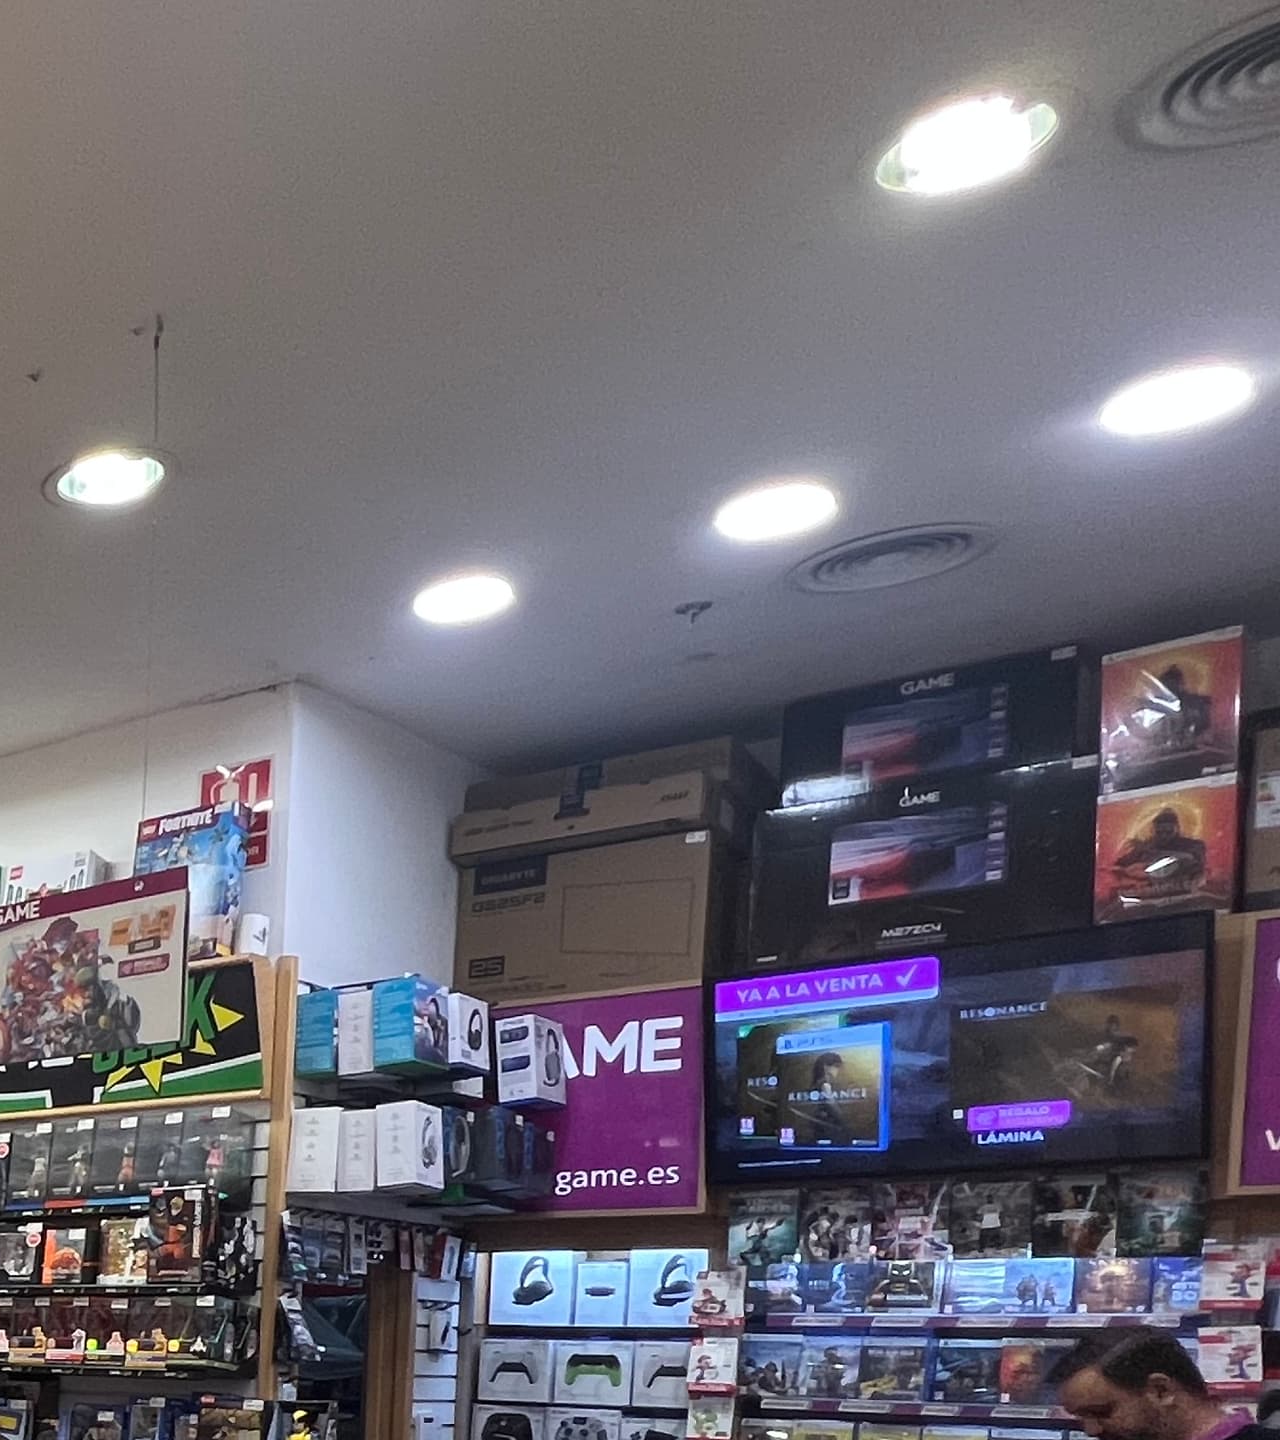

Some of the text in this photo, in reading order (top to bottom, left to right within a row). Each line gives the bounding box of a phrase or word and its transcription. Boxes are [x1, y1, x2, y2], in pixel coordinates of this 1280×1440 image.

[901, 673, 955, 695] GAME
[900, 790, 940, 807] GAME
[158, 809, 213, 836] FORTNITE
[737, 973, 883, 1004] YA A LA VENTA
[960, 1001, 1048, 1020] RESONANCE
[561, 1016, 683, 1080] ME
[977, 1130, 1045, 1145] LÁMINA
[554, 1164, 680, 1196] game.es
